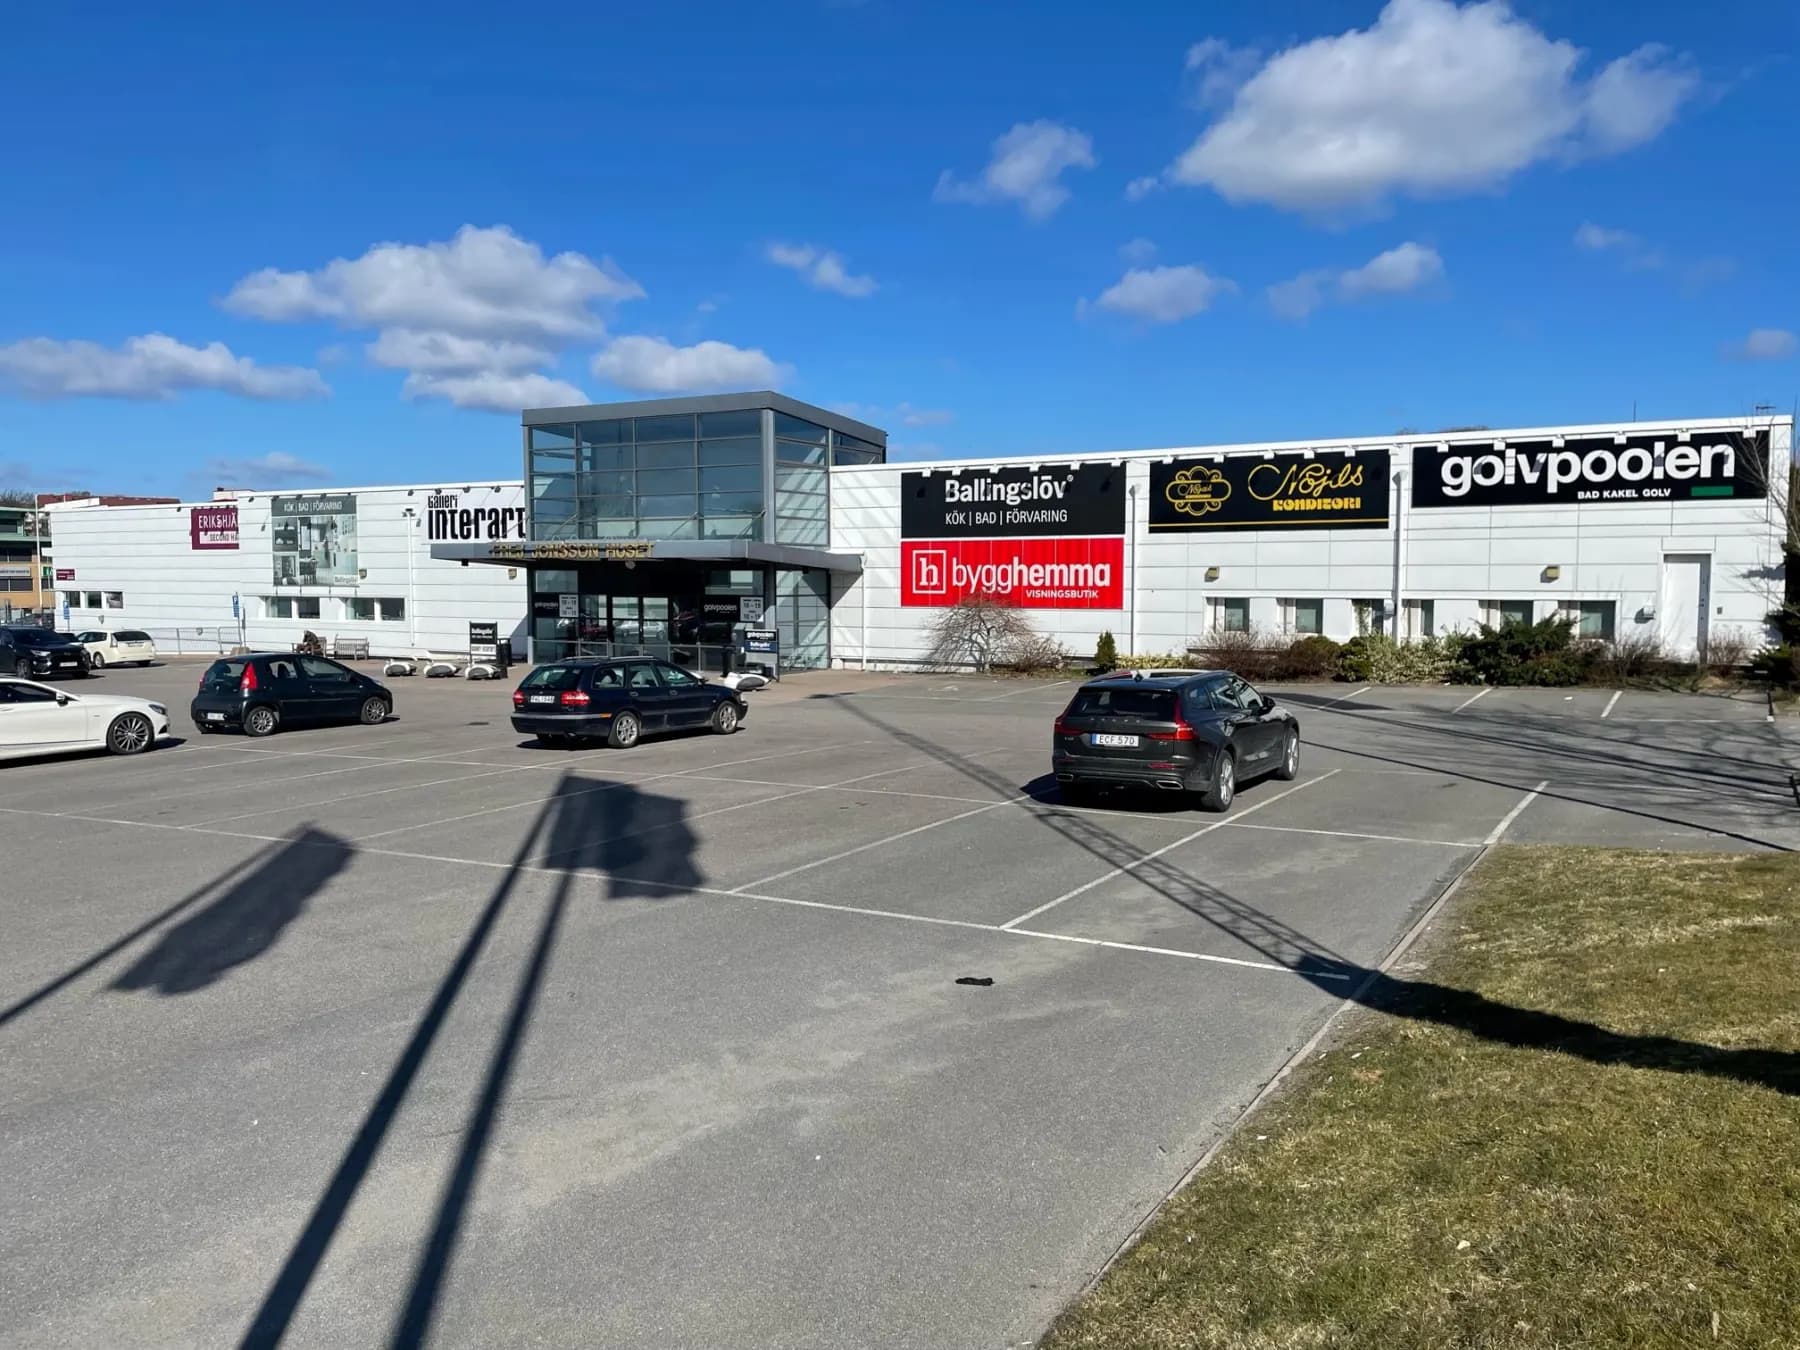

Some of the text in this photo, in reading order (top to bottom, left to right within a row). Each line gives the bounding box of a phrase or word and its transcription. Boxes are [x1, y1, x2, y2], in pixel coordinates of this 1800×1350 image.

[1441, 441, 1735, 497] golvpoolen
[427, 494, 458, 509] Galleri
[1577, 488, 1671, 500] BAD KAKEL GOLV
[1273, 497, 1361, 511] KONDITORI
[427, 507, 526, 540] interart
[945, 508, 1068, 525] KÖK BAD FÖRVARING
[531, 543, 600, 561] JONSSON
[604, 543, 654, 560] HUSET
[919, 557, 940, 586] h
[952, 556, 1110, 594] bygghemma
[1026, 589, 1099, 599] VISNINGSBUTIK
[1099, 735, 1114, 744] ECF
